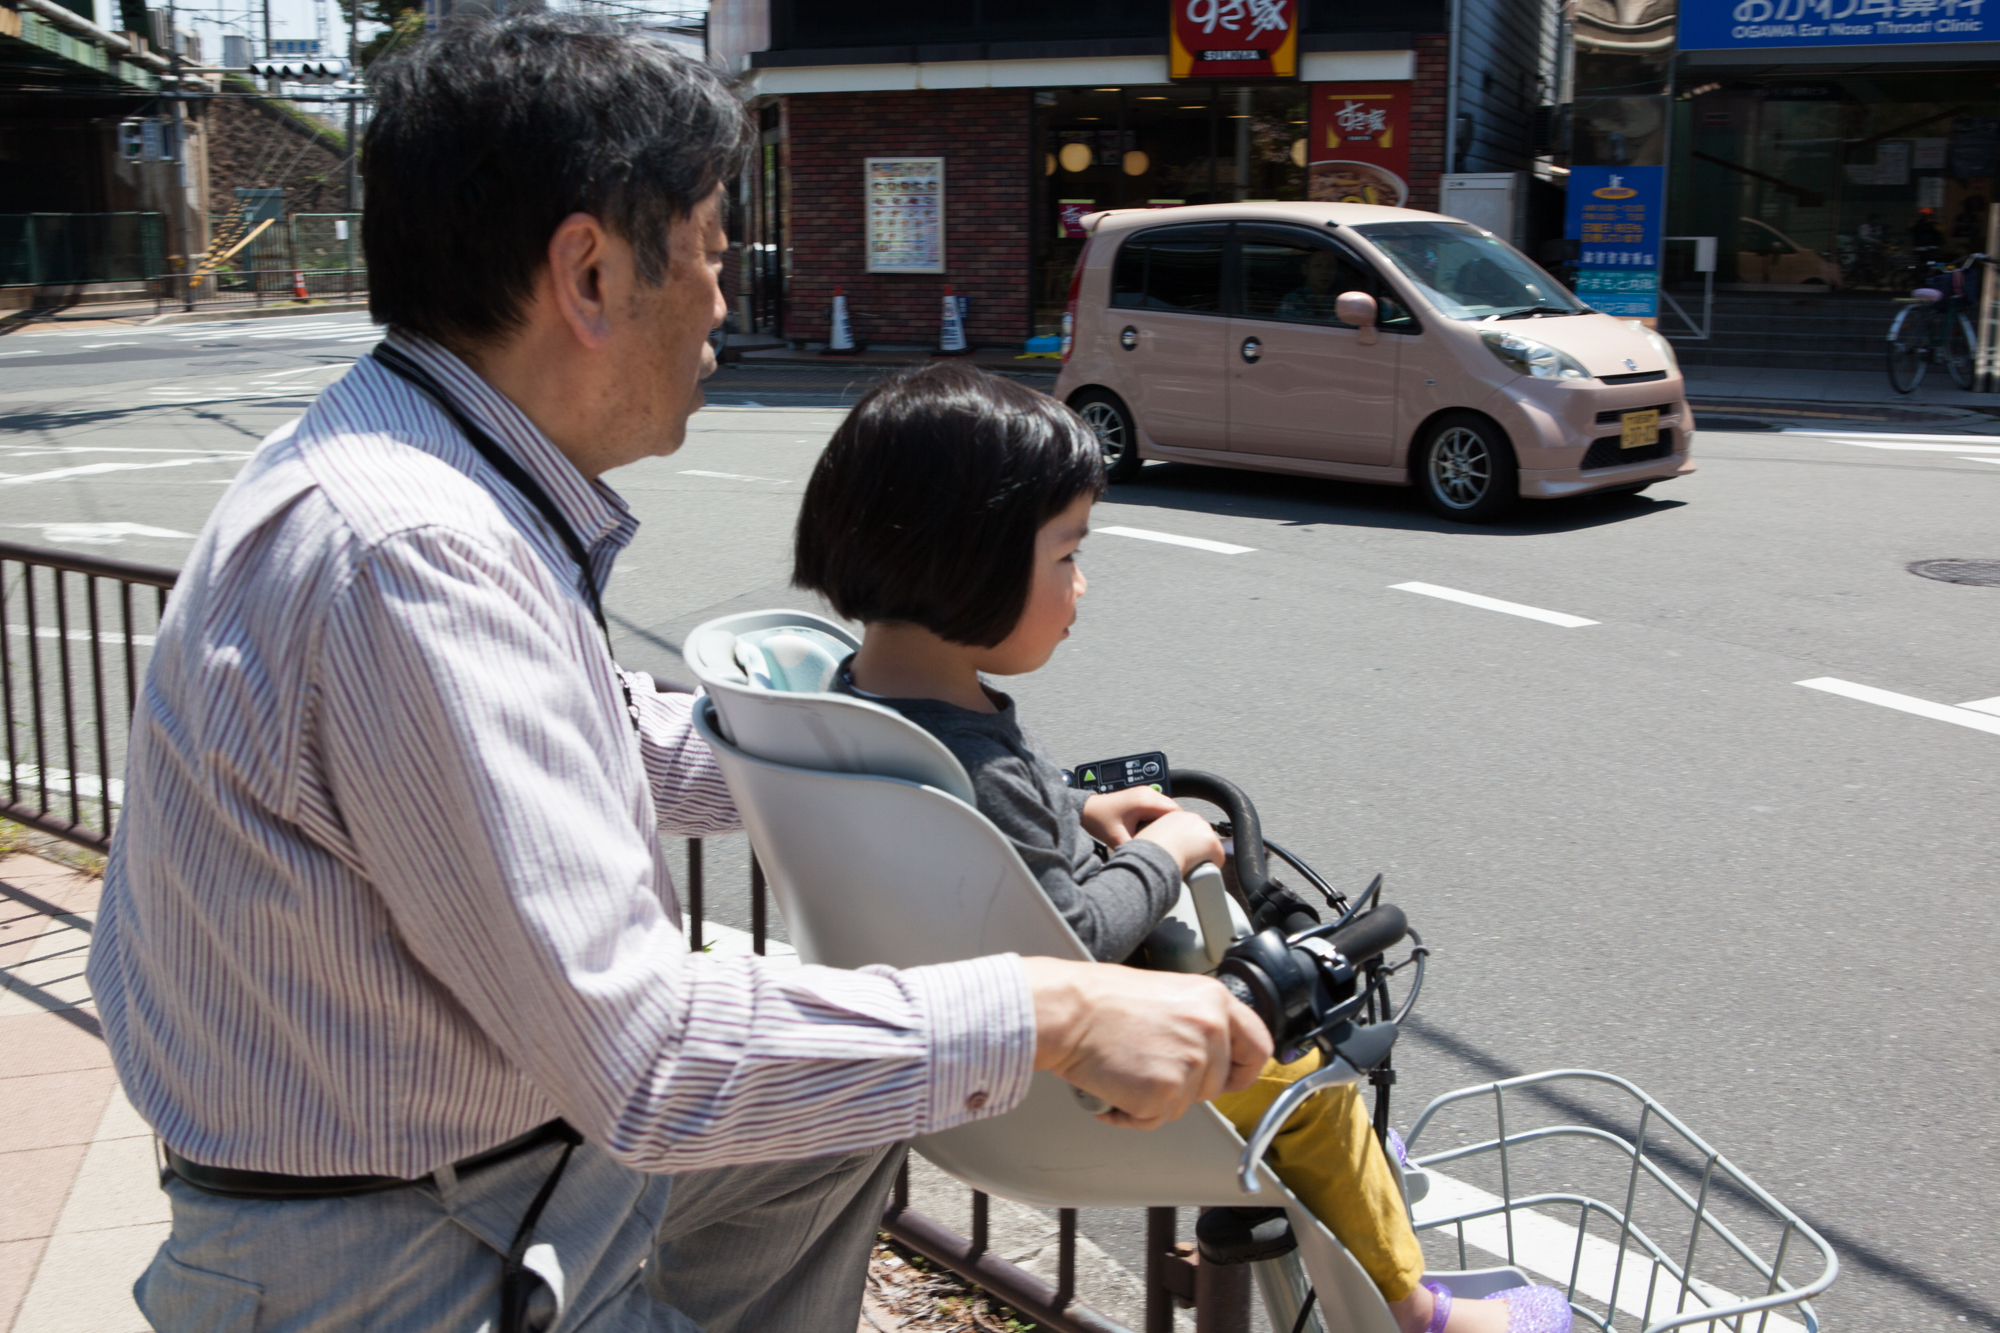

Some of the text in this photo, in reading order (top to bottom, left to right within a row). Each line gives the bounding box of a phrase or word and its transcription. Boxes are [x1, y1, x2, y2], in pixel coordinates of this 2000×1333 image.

[1732, 18, 1984, 38] OGAWA Ear Nose Throat Clinic
[1203, 50, 1261, 61] SUKIYA
